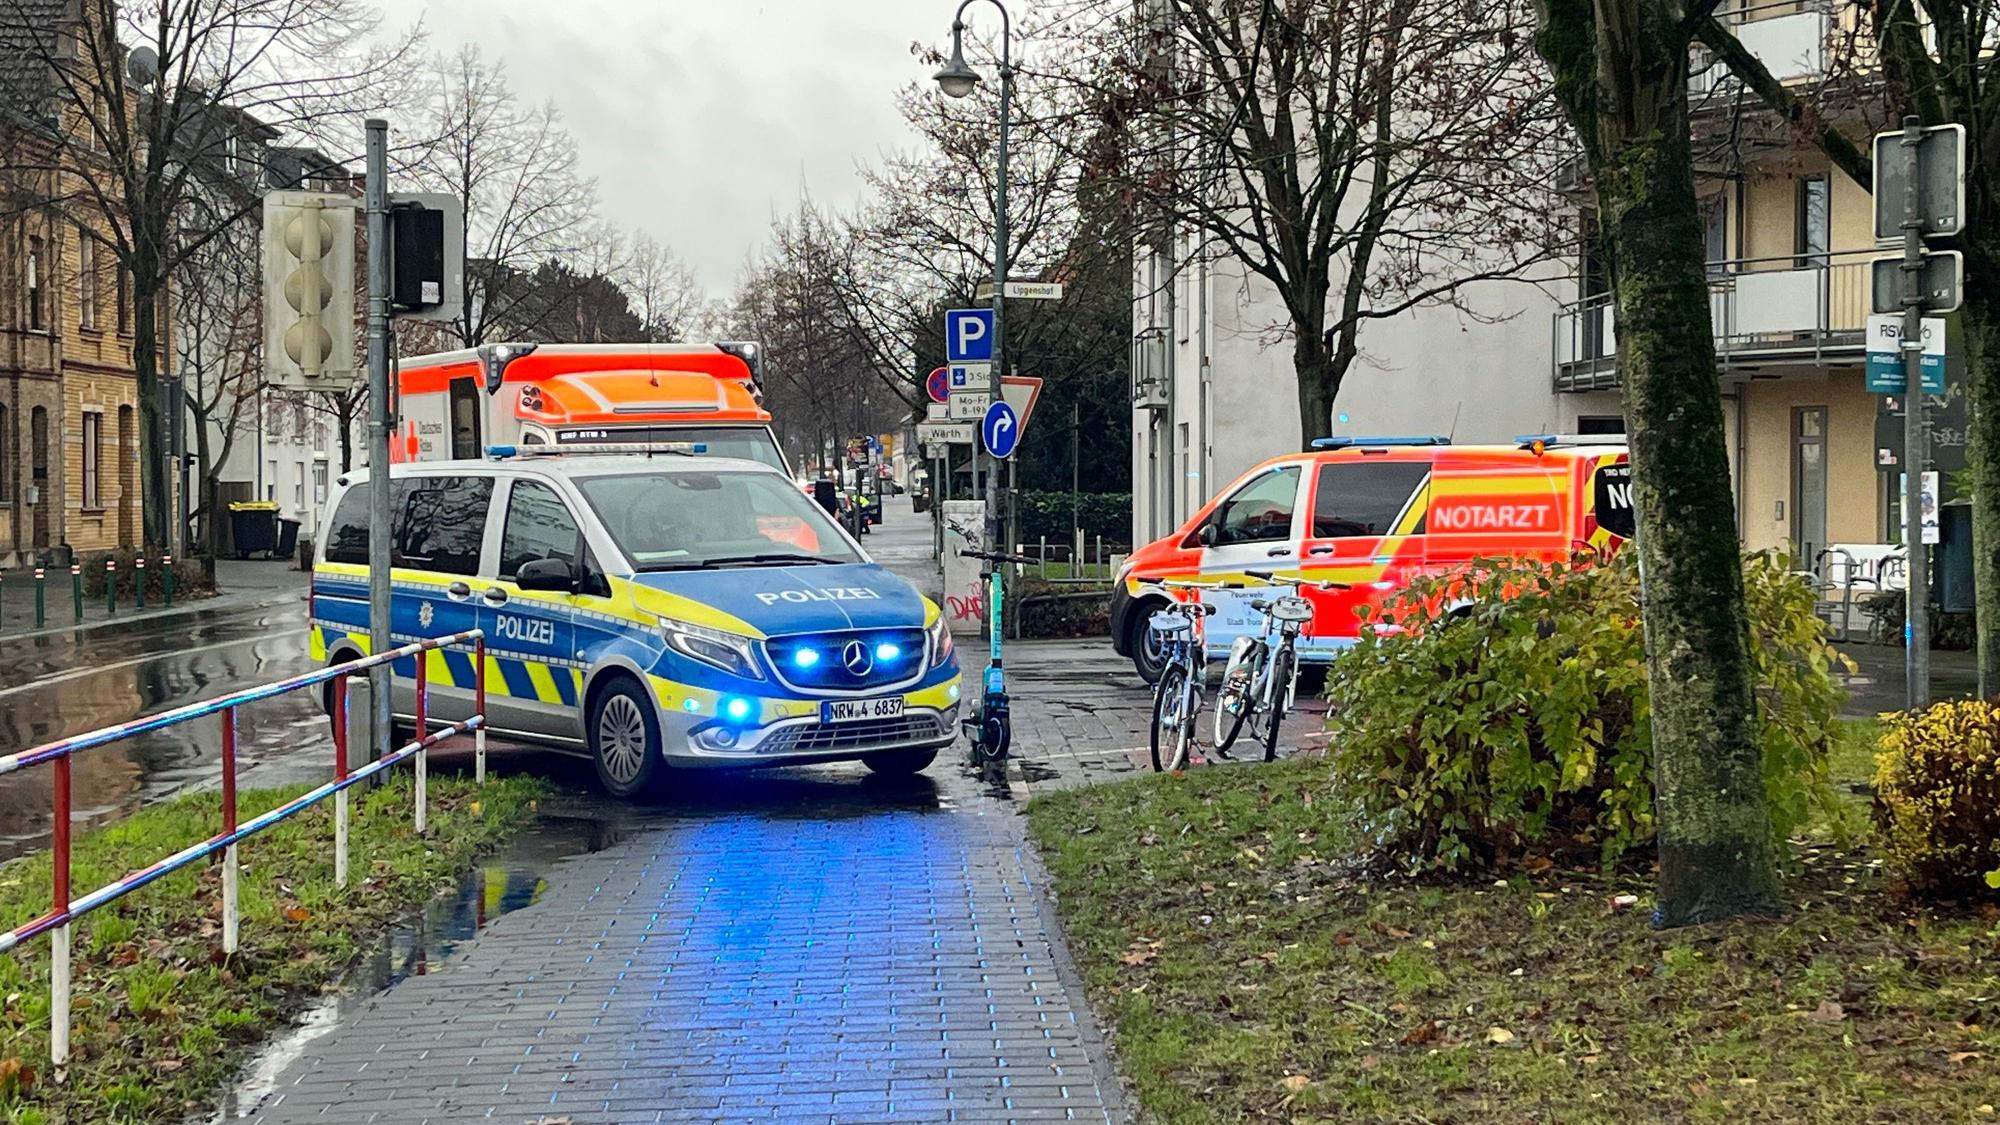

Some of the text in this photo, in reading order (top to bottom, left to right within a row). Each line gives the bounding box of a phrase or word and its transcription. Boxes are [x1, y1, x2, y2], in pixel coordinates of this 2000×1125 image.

[959, 316, 986, 355] P
[959, 396, 987, 405] Mo-Fr
[1434, 504, 1551, 529] NOTARZT
[754, 587, 881, 606] POLIZEI
[495, 614, 554, 645] POLIZEI
[831, 700, 901, 719] NRW 4 6837
